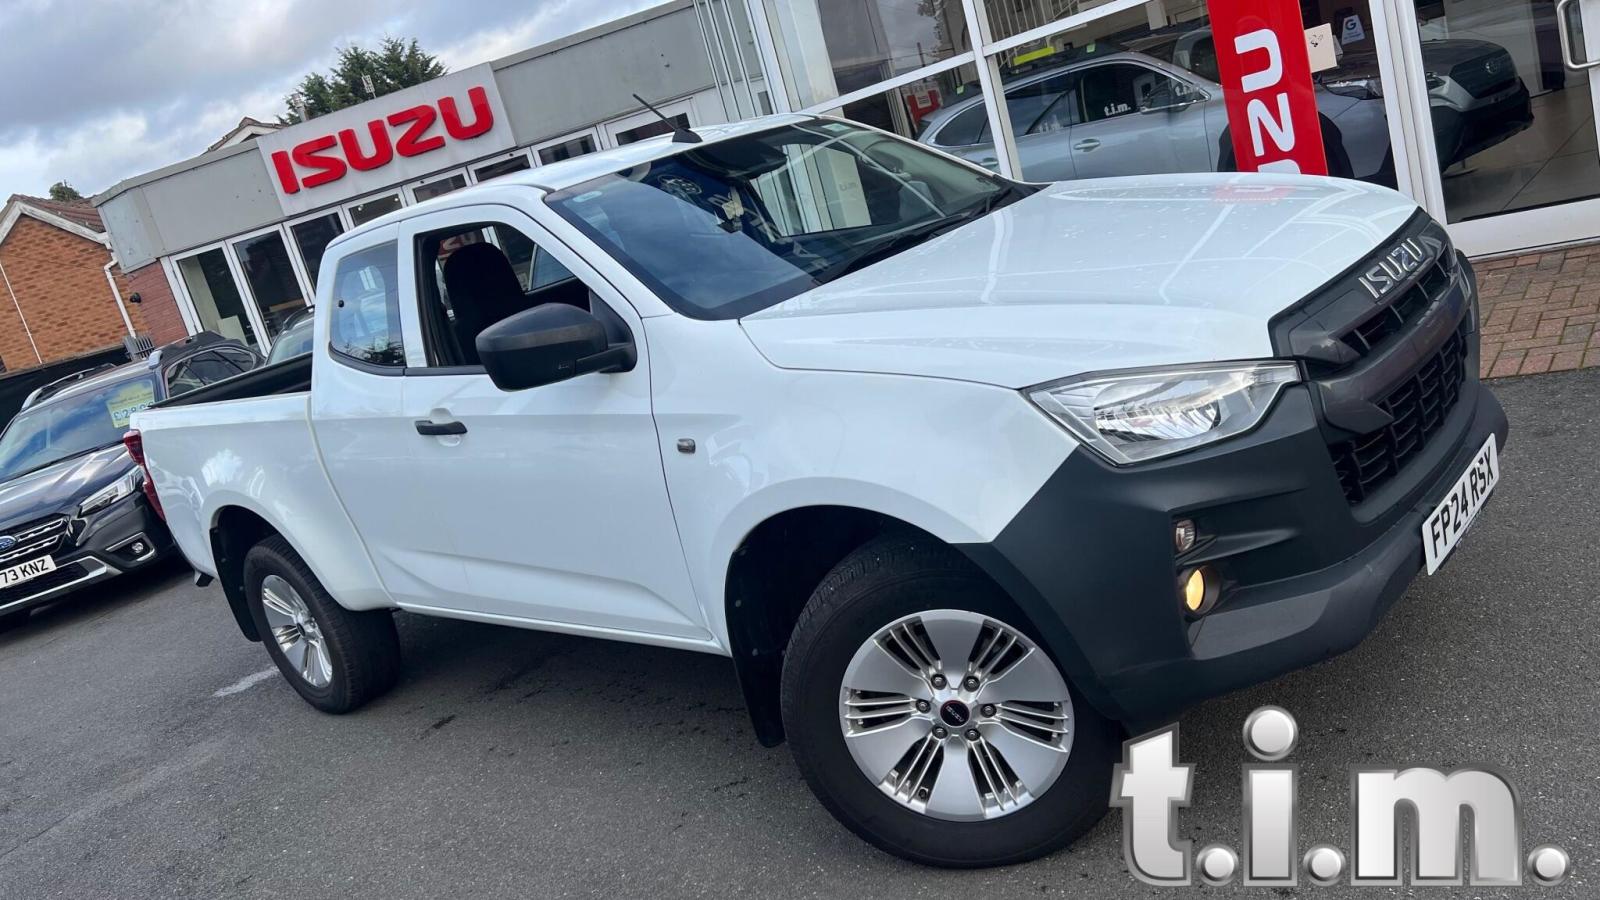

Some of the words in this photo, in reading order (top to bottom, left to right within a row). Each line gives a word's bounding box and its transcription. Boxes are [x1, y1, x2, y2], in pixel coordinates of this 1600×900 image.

[271, 86, 494, 194] ISUZU
[1104, 103, 1132, 116] t.i.m.
[1358, 237, 1424, 299] ISUZU
[1430, 481, 1469, 559] FP24
[1469, 446, 1494, 507] RSX
[19, 559, 49, 578] KNZ
